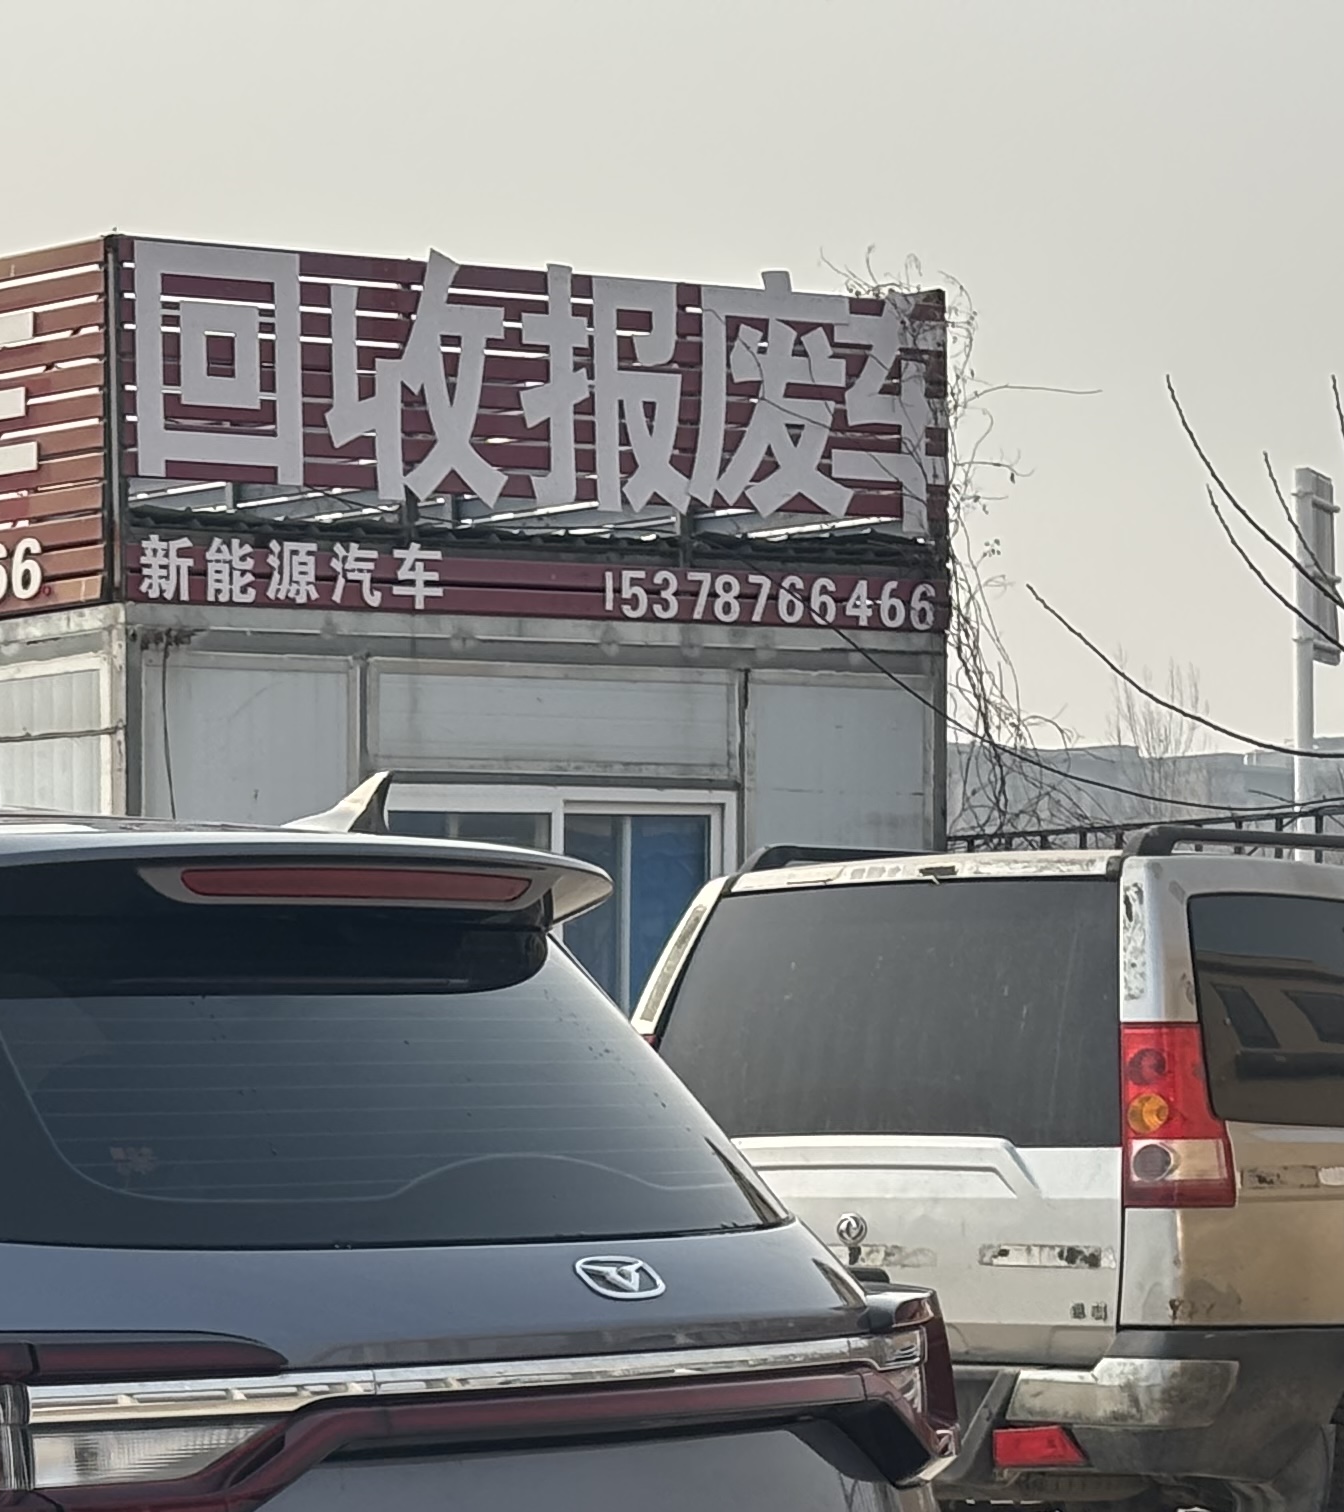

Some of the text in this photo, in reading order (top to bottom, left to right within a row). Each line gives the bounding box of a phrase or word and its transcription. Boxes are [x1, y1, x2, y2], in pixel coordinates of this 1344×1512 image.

[134, 248, 947, 536] 回收报废车
[139, 534, 444, 610] 新能源汽车
[604, 570, 937, 631] 15378766466
